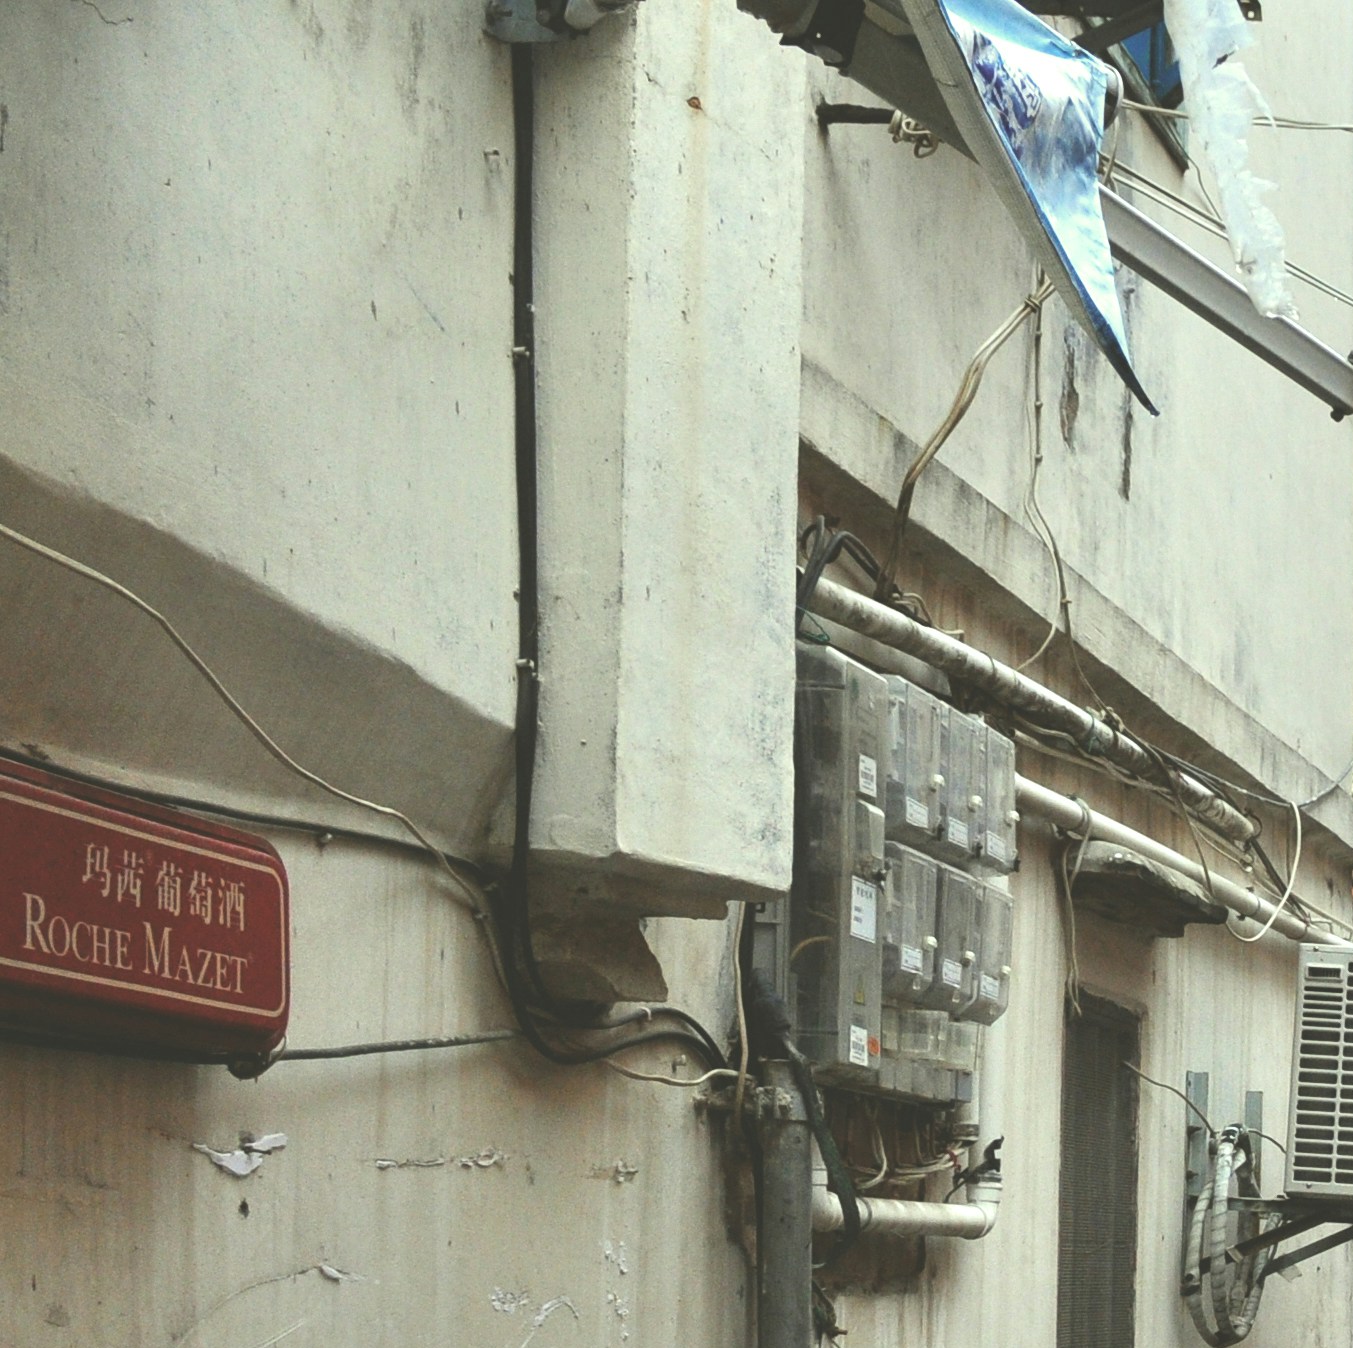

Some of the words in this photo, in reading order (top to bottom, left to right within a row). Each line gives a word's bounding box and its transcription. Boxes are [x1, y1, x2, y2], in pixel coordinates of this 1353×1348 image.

[155, 860, 246, 932] 葡萄酒
[22, 891, 133, 971] ROCHE
[142, 921, 248, 994] MAZET
